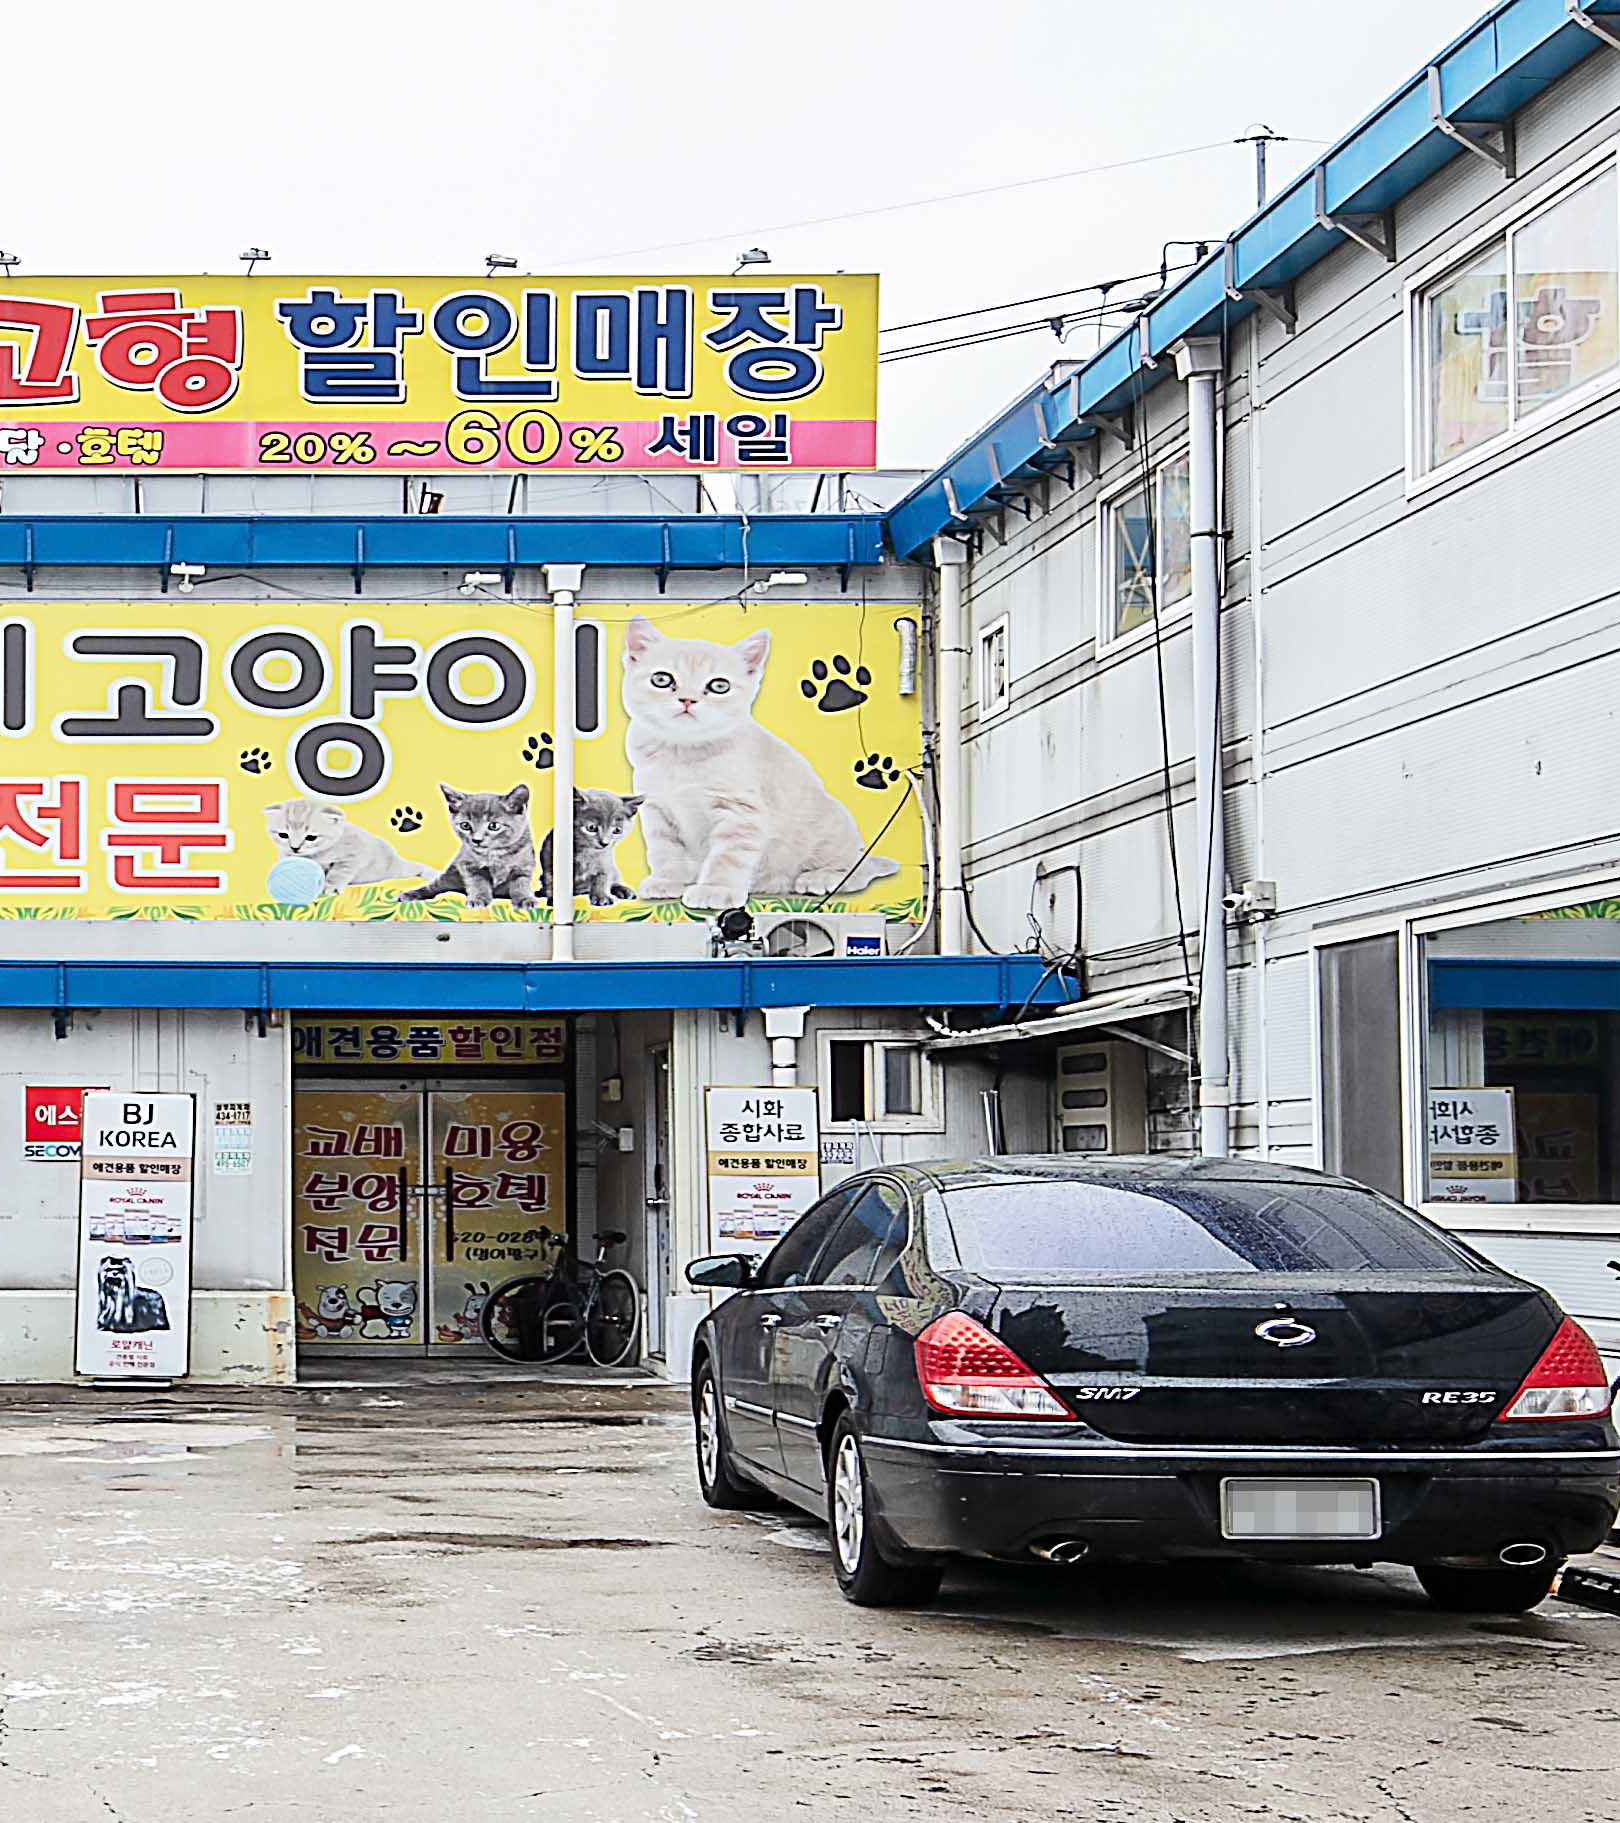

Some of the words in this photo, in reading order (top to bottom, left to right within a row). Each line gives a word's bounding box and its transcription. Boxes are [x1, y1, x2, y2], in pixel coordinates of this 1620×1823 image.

[280, 289, 845, 399] 할인매장
[76, 427, 164, 465] 호텔
[259, 430, 376, 465] 20%
[647, 411, 793, 465] 세일
[847, 946, 880, 955] Haier
[35, 1104, 82, 1126] 에스
[123, 1103, 154, 1125] BJ
[741, 1099, 784, 1119] 시화
[99, 1130, 178, 1148] KOREA
[300, 1123, 405, 1158] 교배
[443, 1120, 552, 1163] 미용
[719, 1122, 806, 1143] 종합사료
[93, 1162, 136, 1174] 애견용품
[138, 1163, 181, 1175] 할인매장
[718, 1158, 761, 1169] 애견용품
[764, 1158, 808, 1170] 할인매장
[300, 1173, 401, 1213] 분양
[452, 1172, 549, 1214] 호텔
[301, 1223, 401, 1264] 전문
[1075, 1387, 1140, 1400] SM7
[1421, 1391, 1496, 1404] RE35
